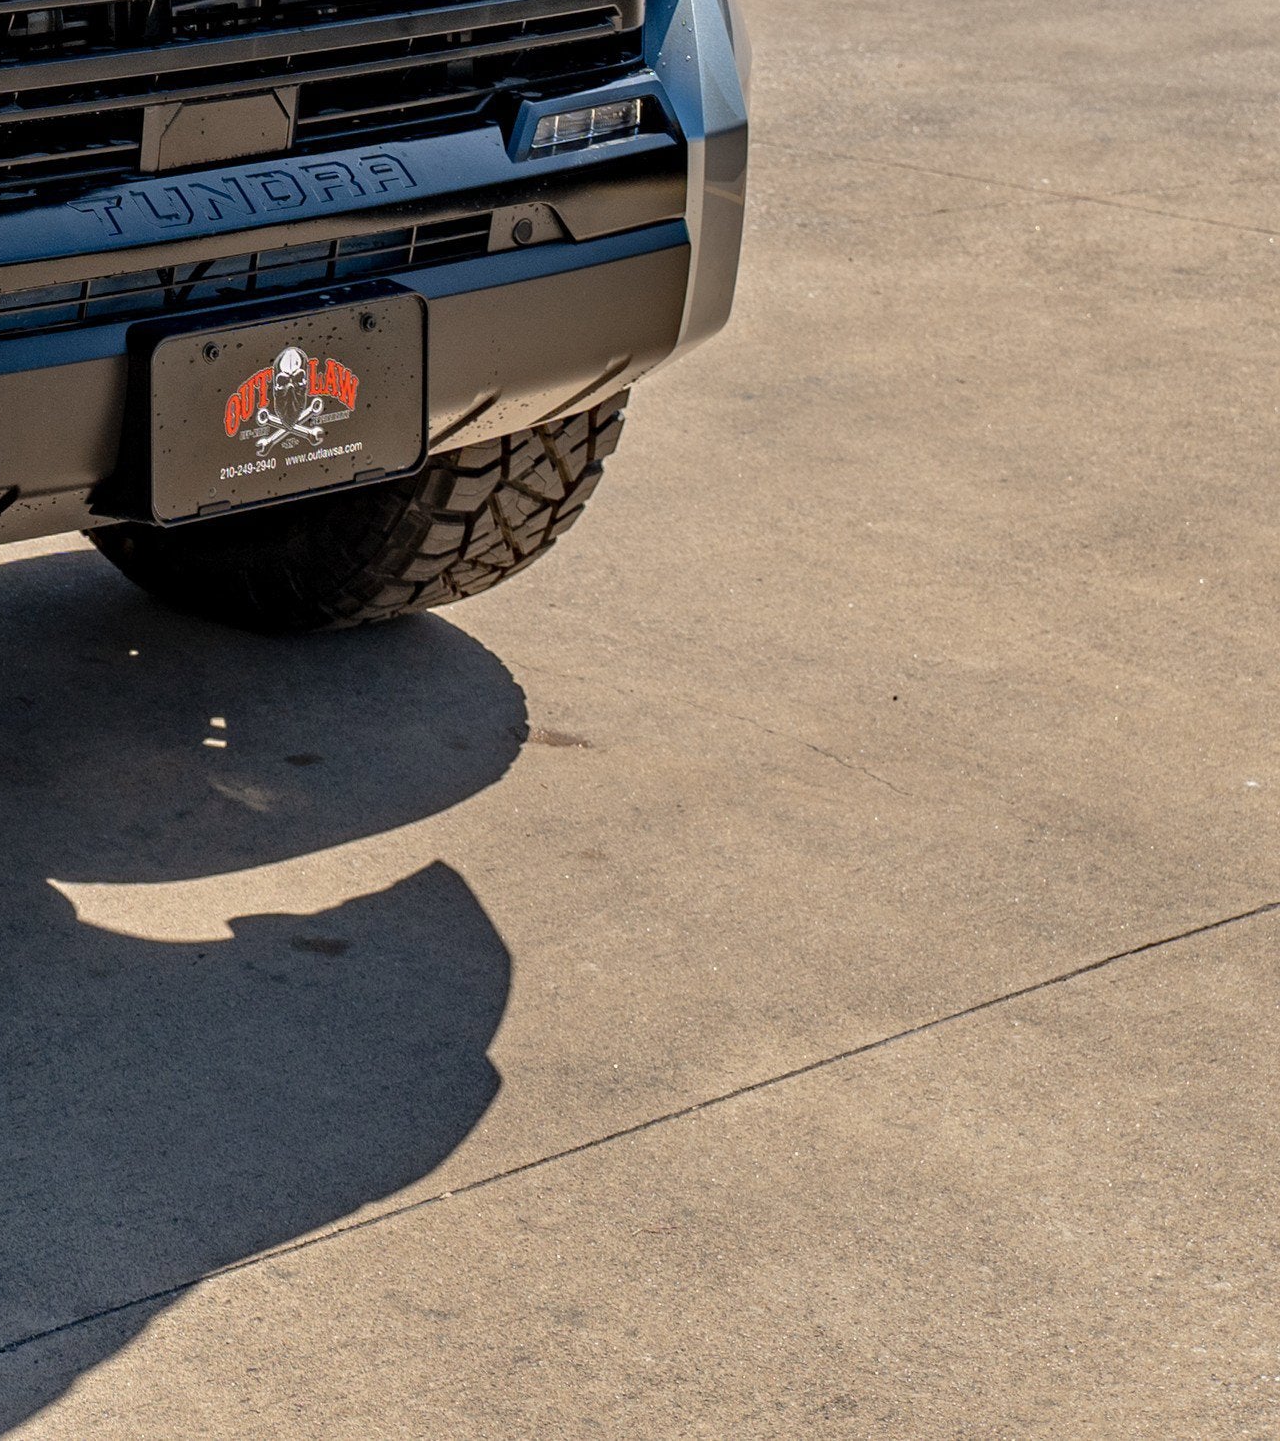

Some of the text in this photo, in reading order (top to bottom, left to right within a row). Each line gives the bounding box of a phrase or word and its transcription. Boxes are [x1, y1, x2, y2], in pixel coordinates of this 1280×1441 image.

[66, 152, 419, 237] TUNDRA
[220, 457, 277, 480] 210-249-2940
[285, 441, 363, 466] www.outlawsa.com
